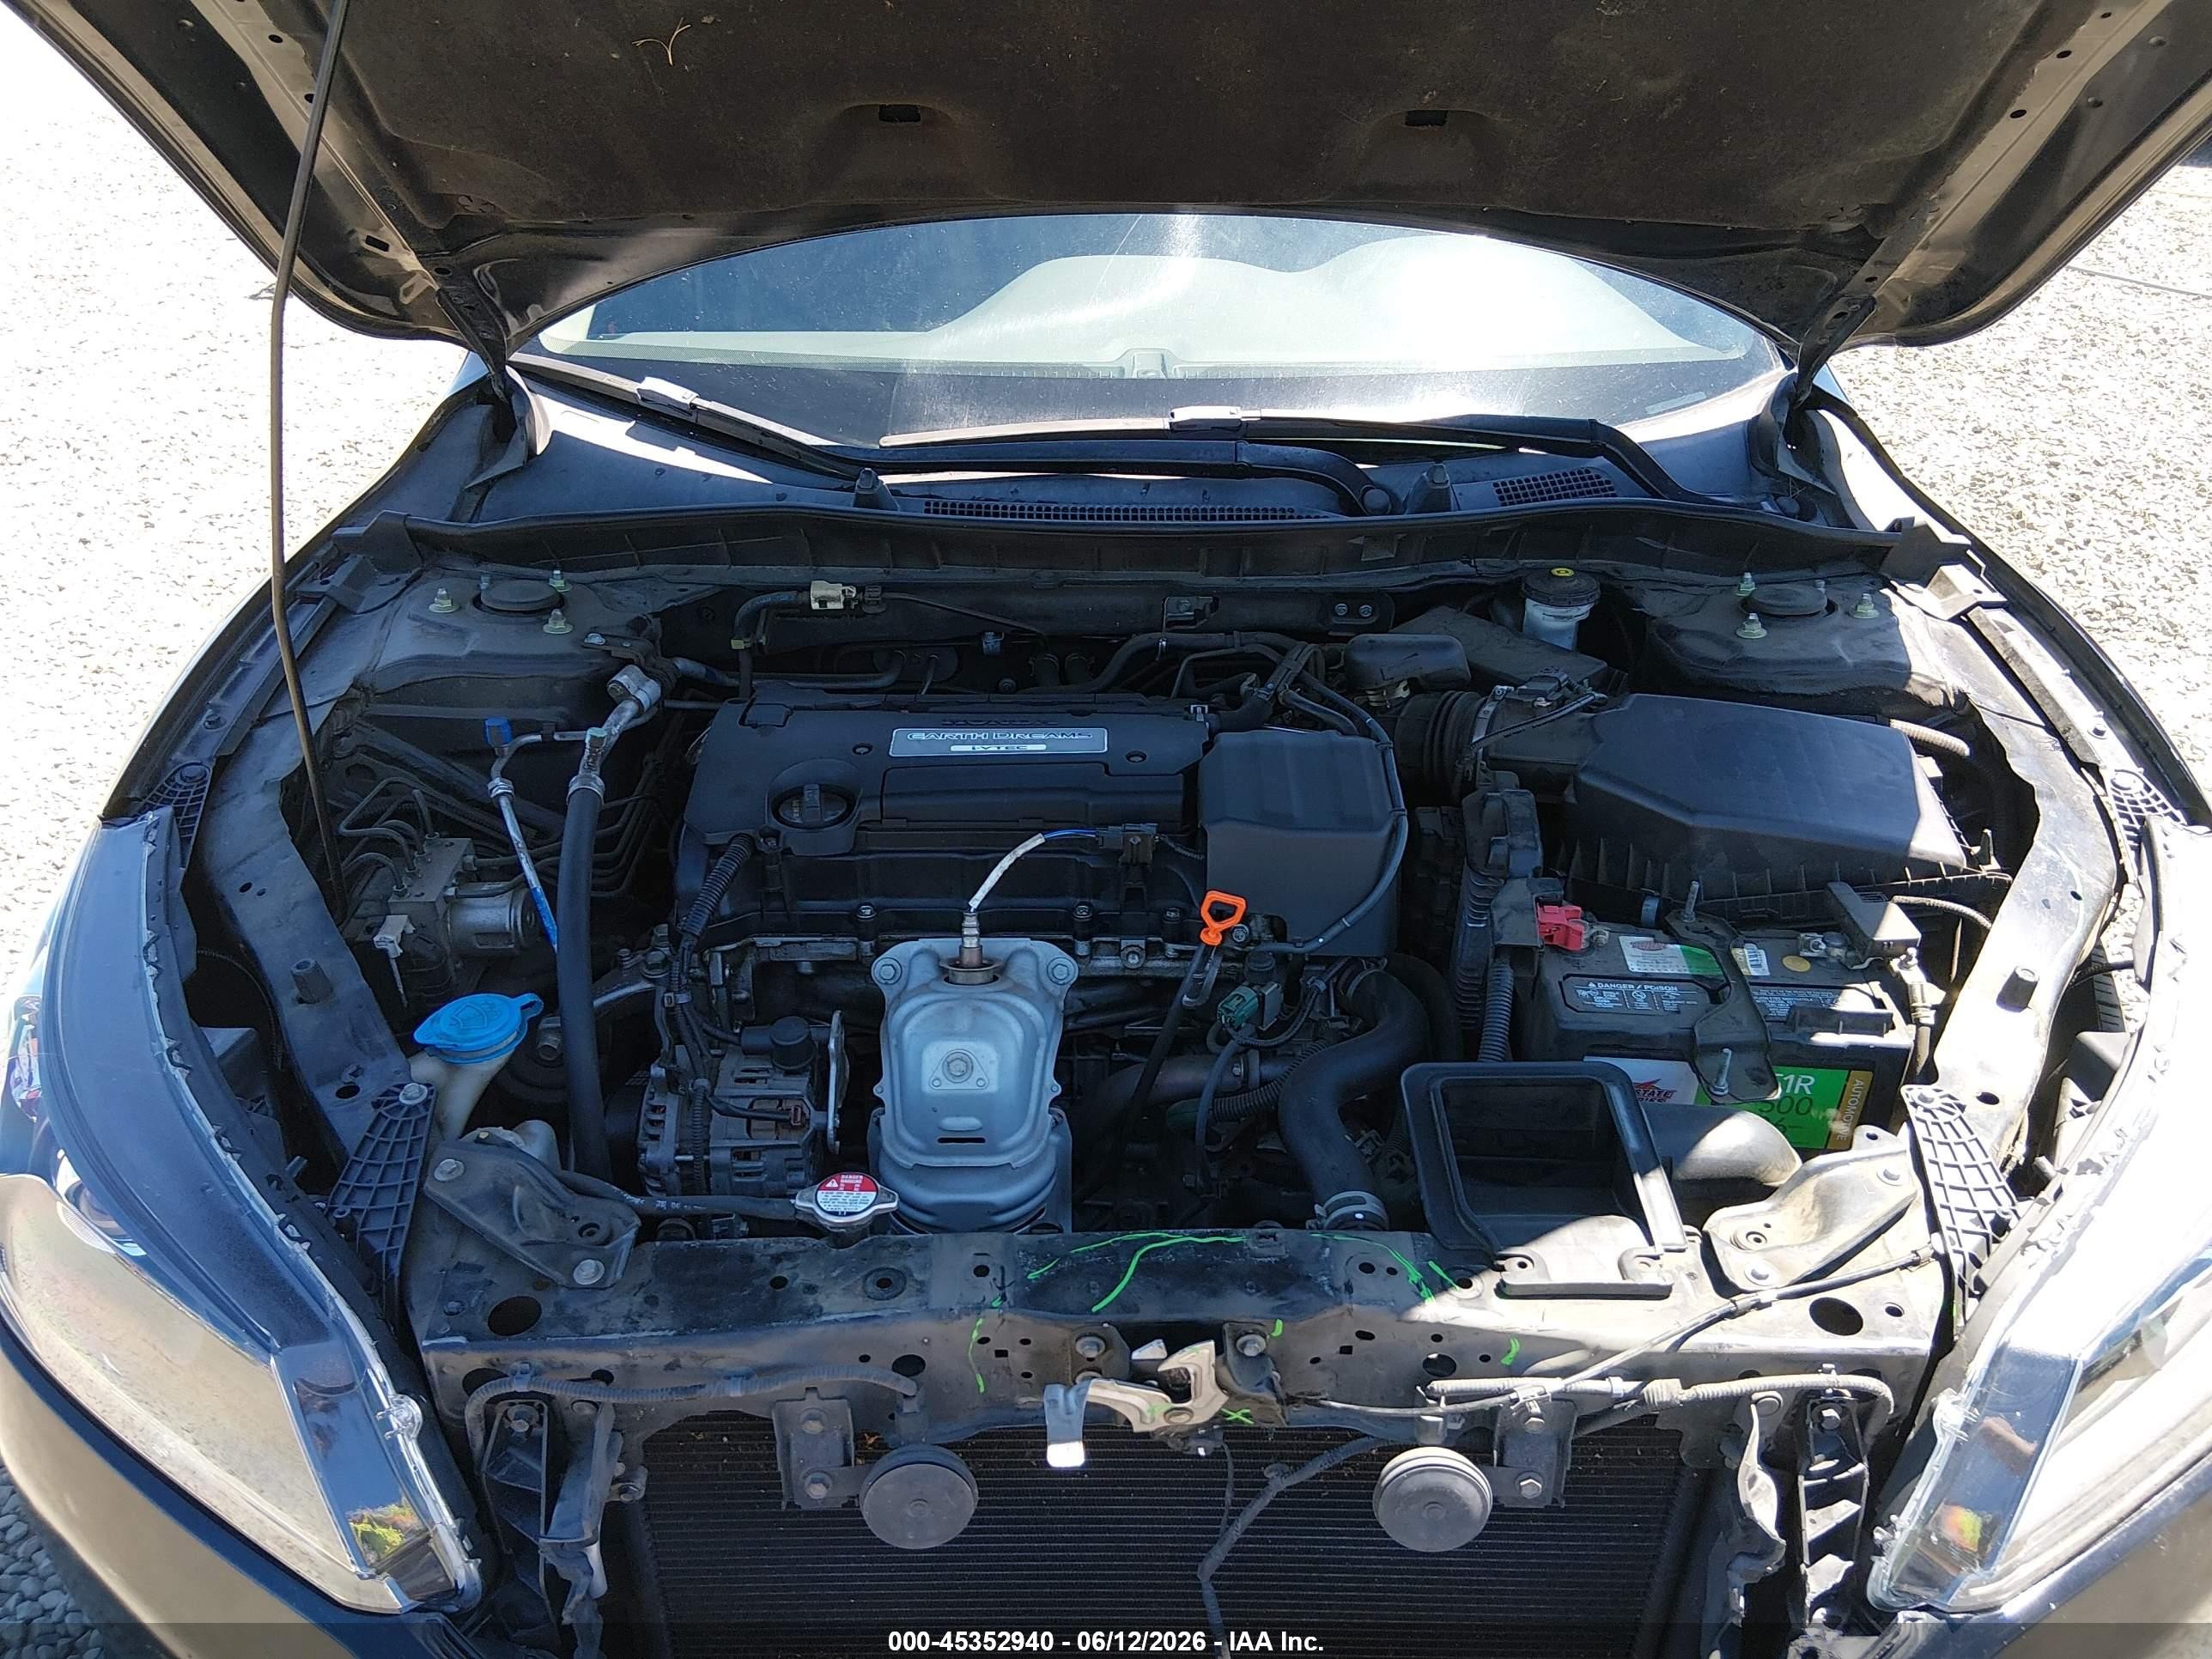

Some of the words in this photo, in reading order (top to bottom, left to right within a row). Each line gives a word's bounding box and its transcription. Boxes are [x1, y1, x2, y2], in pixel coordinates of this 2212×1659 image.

[907, 732, 989, 741] EARTH
[993, 732, 1093, 740] DREAMS
[1597, 981, 1635, 990] DANGER
[1837, 1079, 1865, 1141] AUTOMOTIVE
